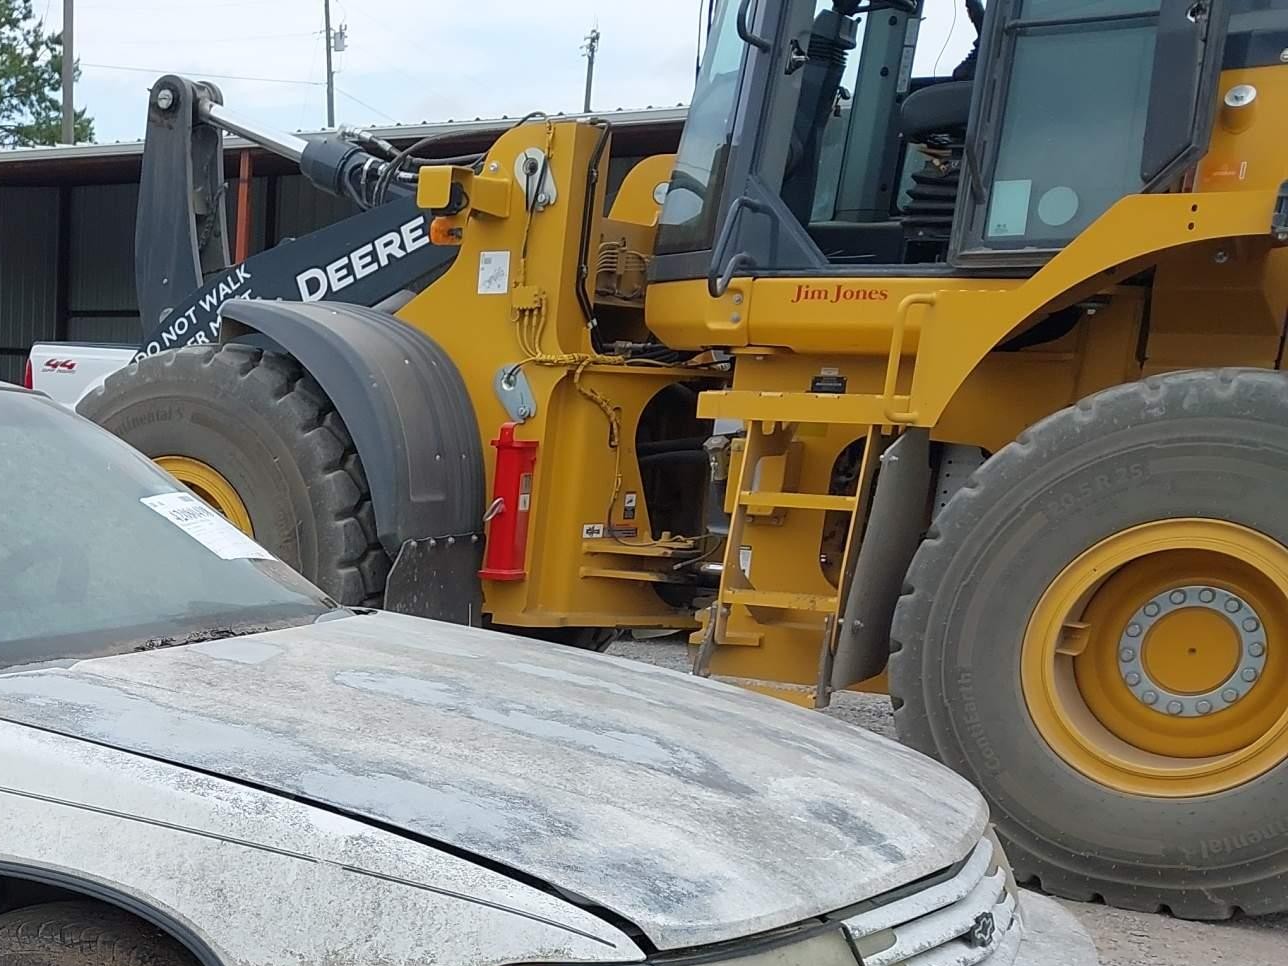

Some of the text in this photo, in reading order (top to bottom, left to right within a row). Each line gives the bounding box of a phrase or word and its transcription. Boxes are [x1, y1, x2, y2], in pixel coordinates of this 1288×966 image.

[295, 215, 430, 303] DEERE
[791, 284, 889, 304] Jim Jones
[161, 306, 197, 347] NOT
[198, 263, 252, 313] WALK
